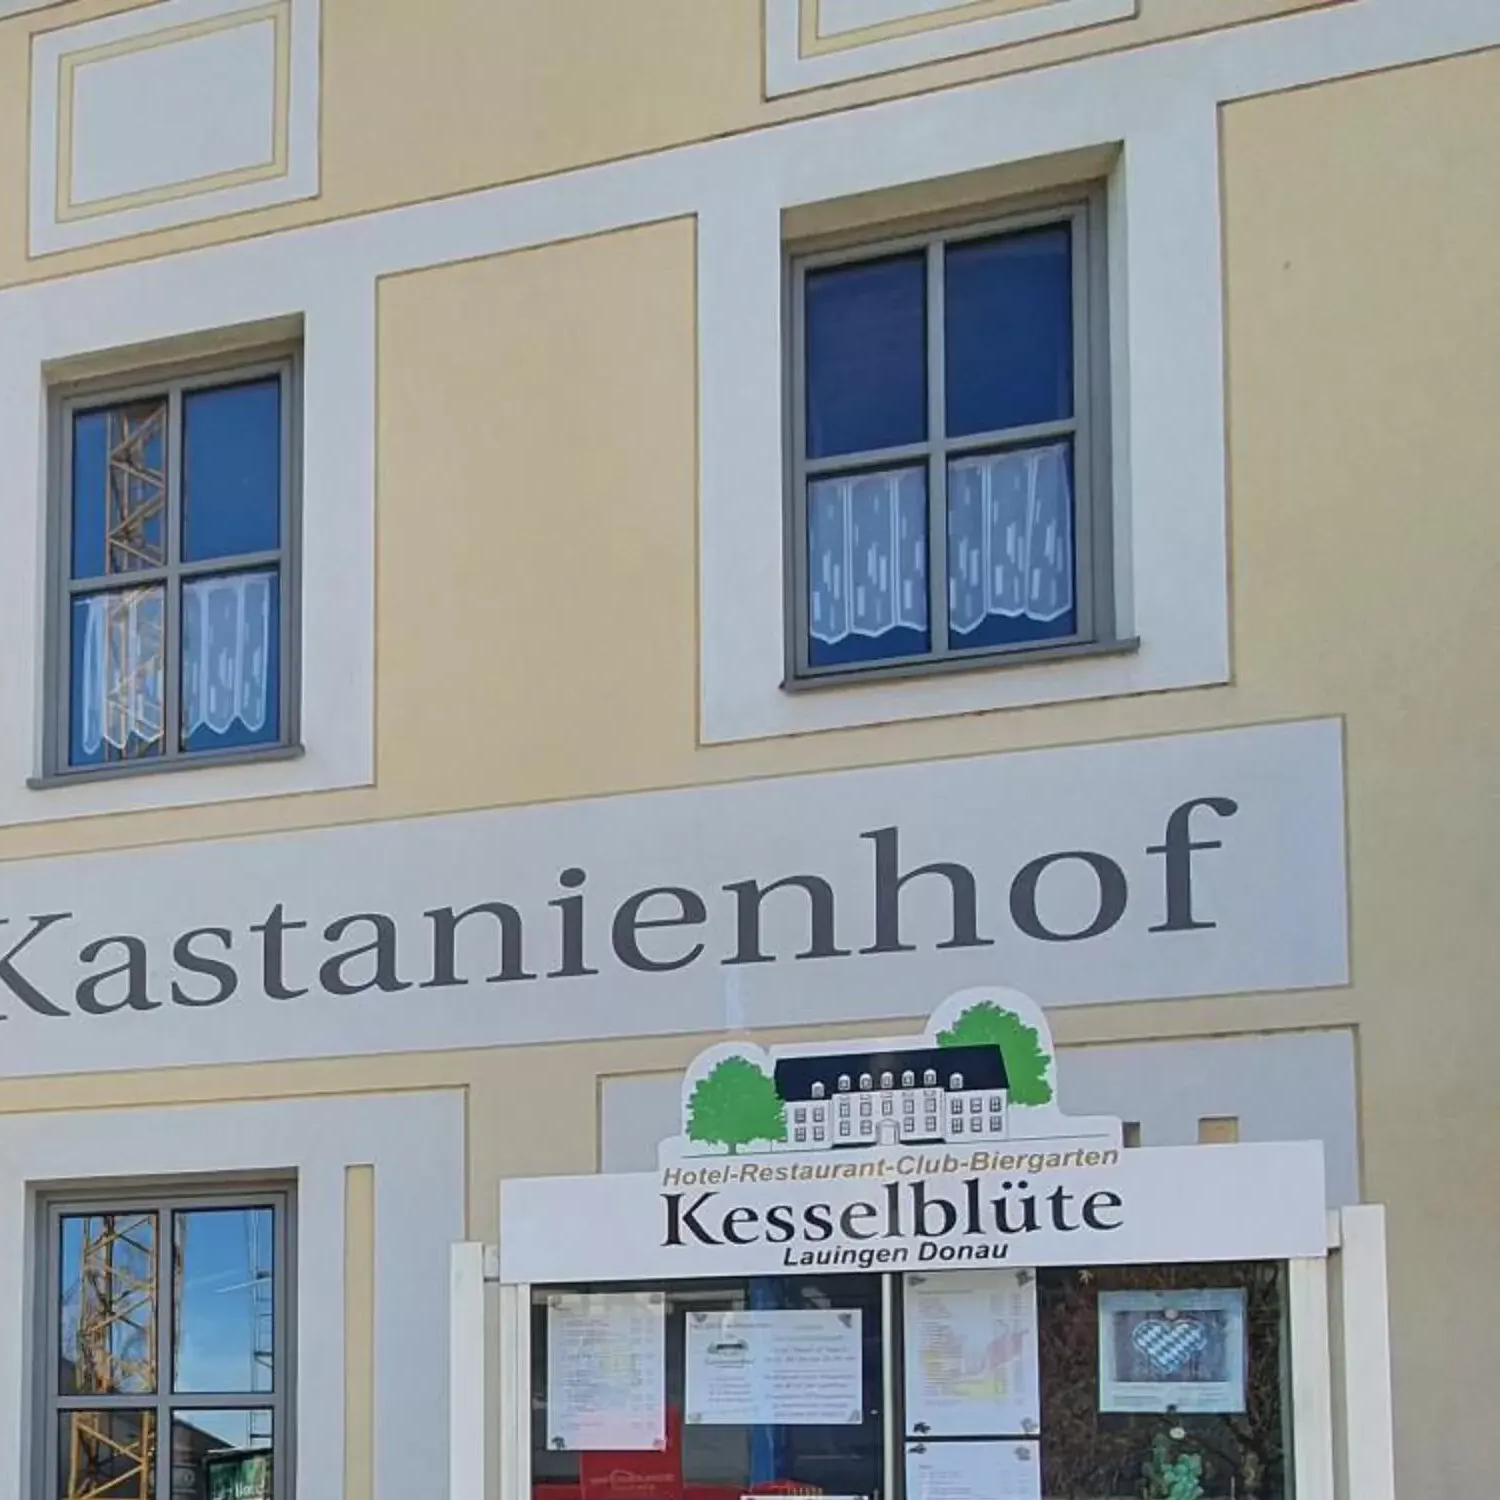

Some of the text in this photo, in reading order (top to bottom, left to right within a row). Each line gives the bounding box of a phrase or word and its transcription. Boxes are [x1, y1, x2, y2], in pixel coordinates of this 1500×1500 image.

[662, 1147, 1119, 1187] Hotel-Restaurant-Club-Biergarten
[659, 1178, 1125, 1247] Kesselblüte
[782, 1241, 1009, 1267] Lauingen Donau
